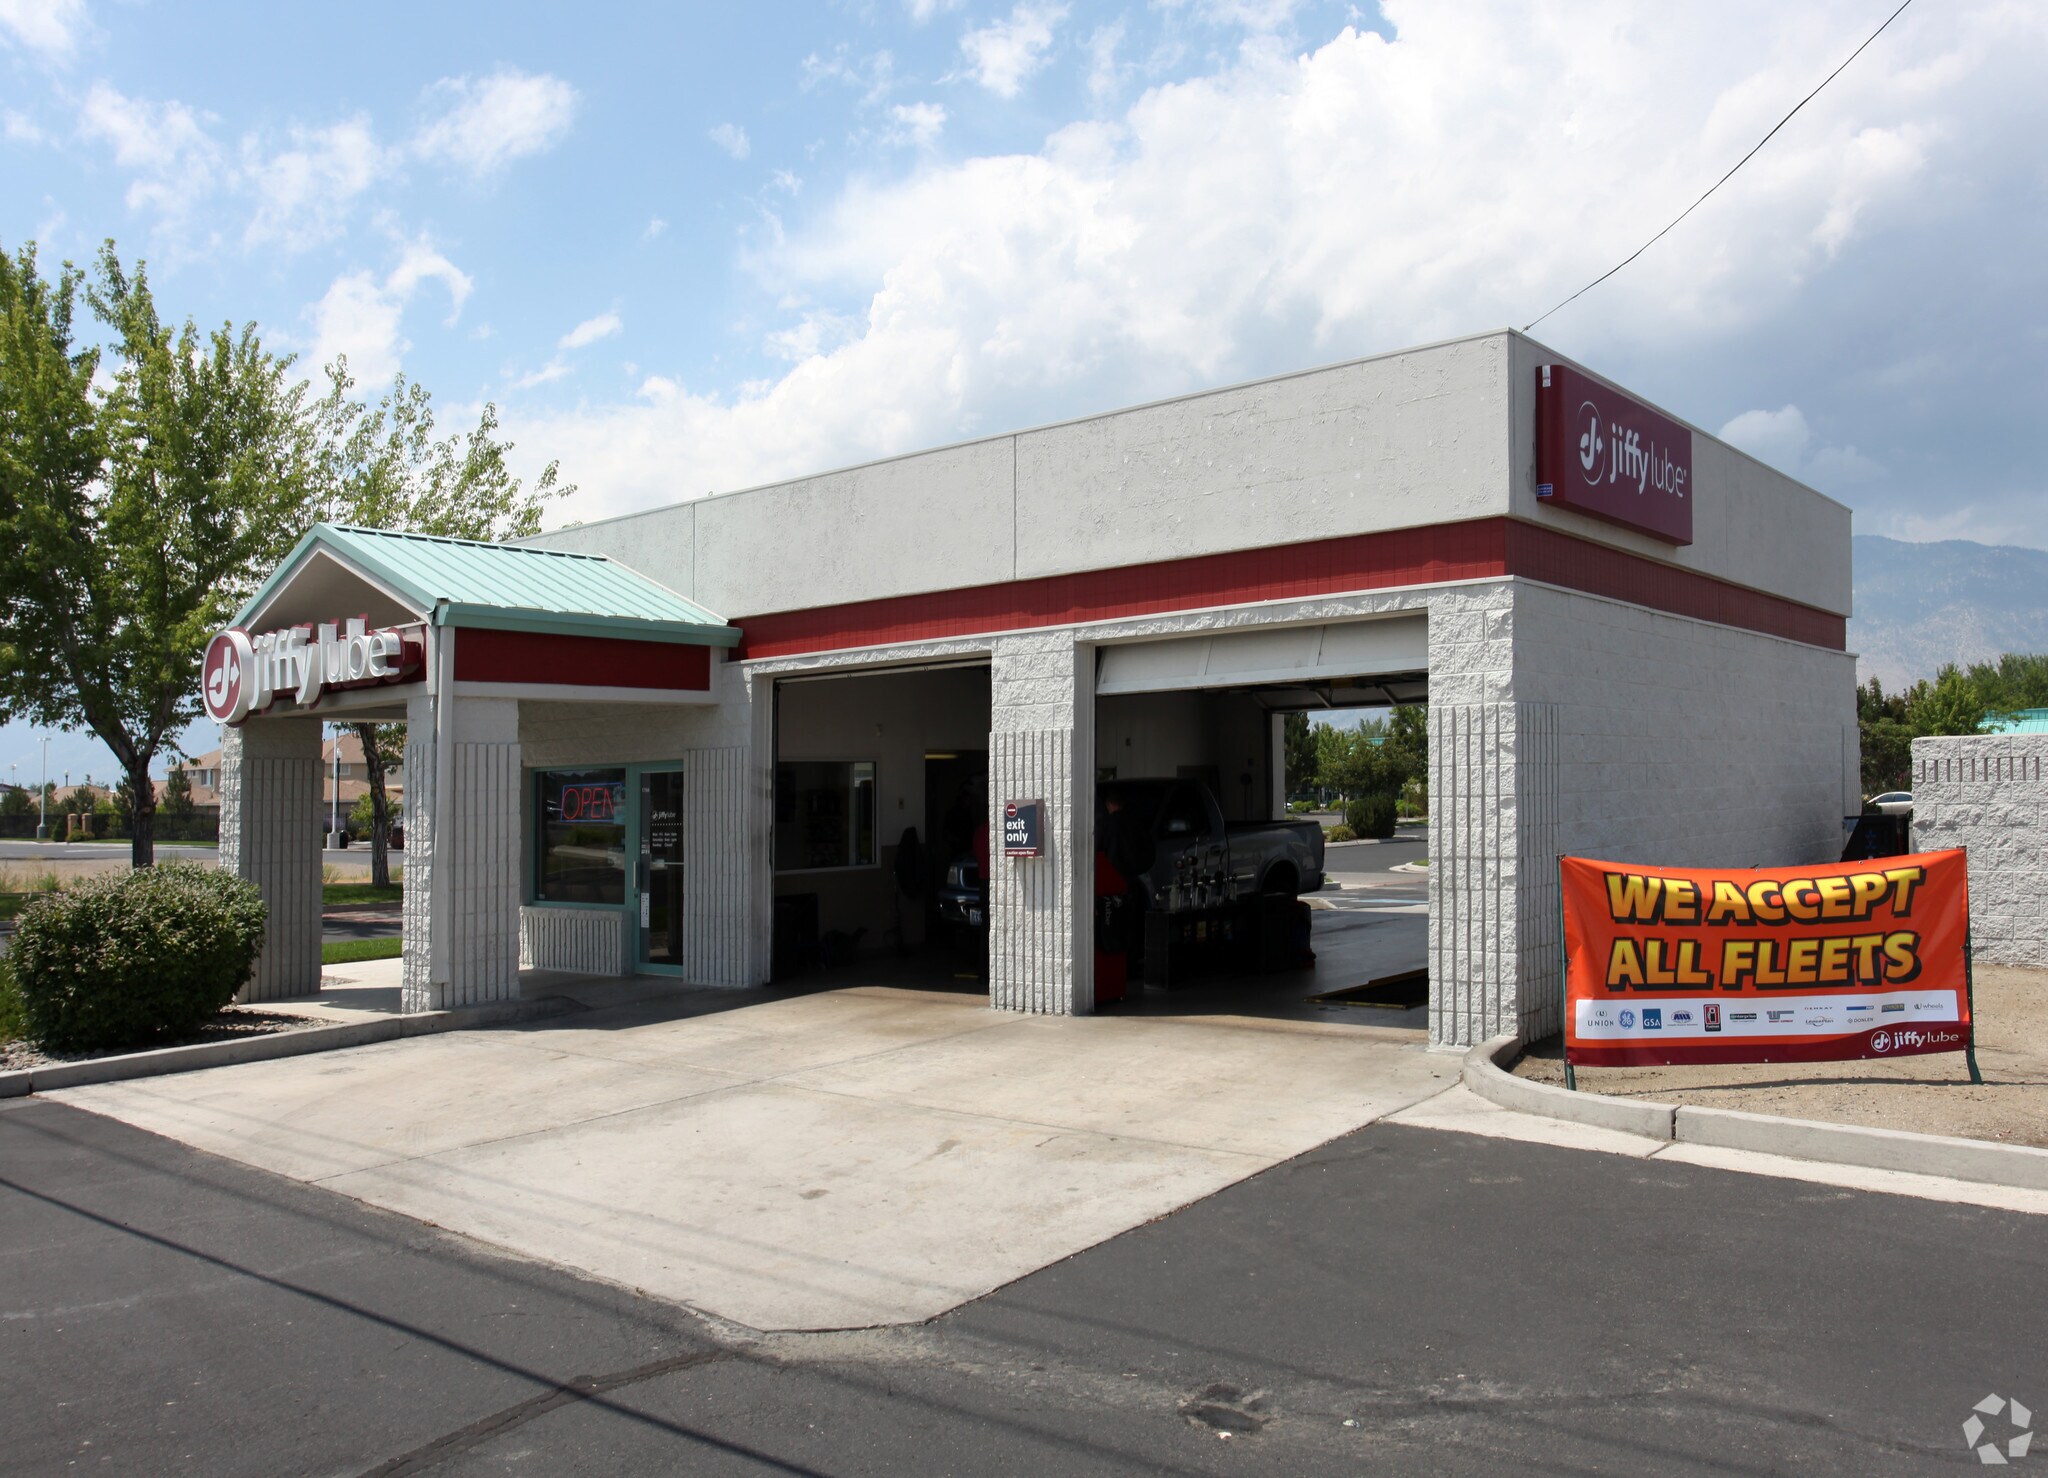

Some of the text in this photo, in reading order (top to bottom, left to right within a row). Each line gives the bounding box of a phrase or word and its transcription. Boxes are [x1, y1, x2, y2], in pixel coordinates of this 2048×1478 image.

[1610, 423, 1684, 497] jiffy lube
[250, 618, 400, 711] jiffy lube
[562, 787, 616, 820] OPEN
[1006, 818, 1025, 830] exit
[1006, 830, 1028, 844] only
[1604, 866, 1926, 926] WE ACCEPT
[1606, 930, 1922, 992] ALL FLEETS
[1587, 1019, 1614, 1027] UNION
[1643, 1018, 1661, 1027] GSA
[1894, 1031, 1959, 1049] jiffy lube
